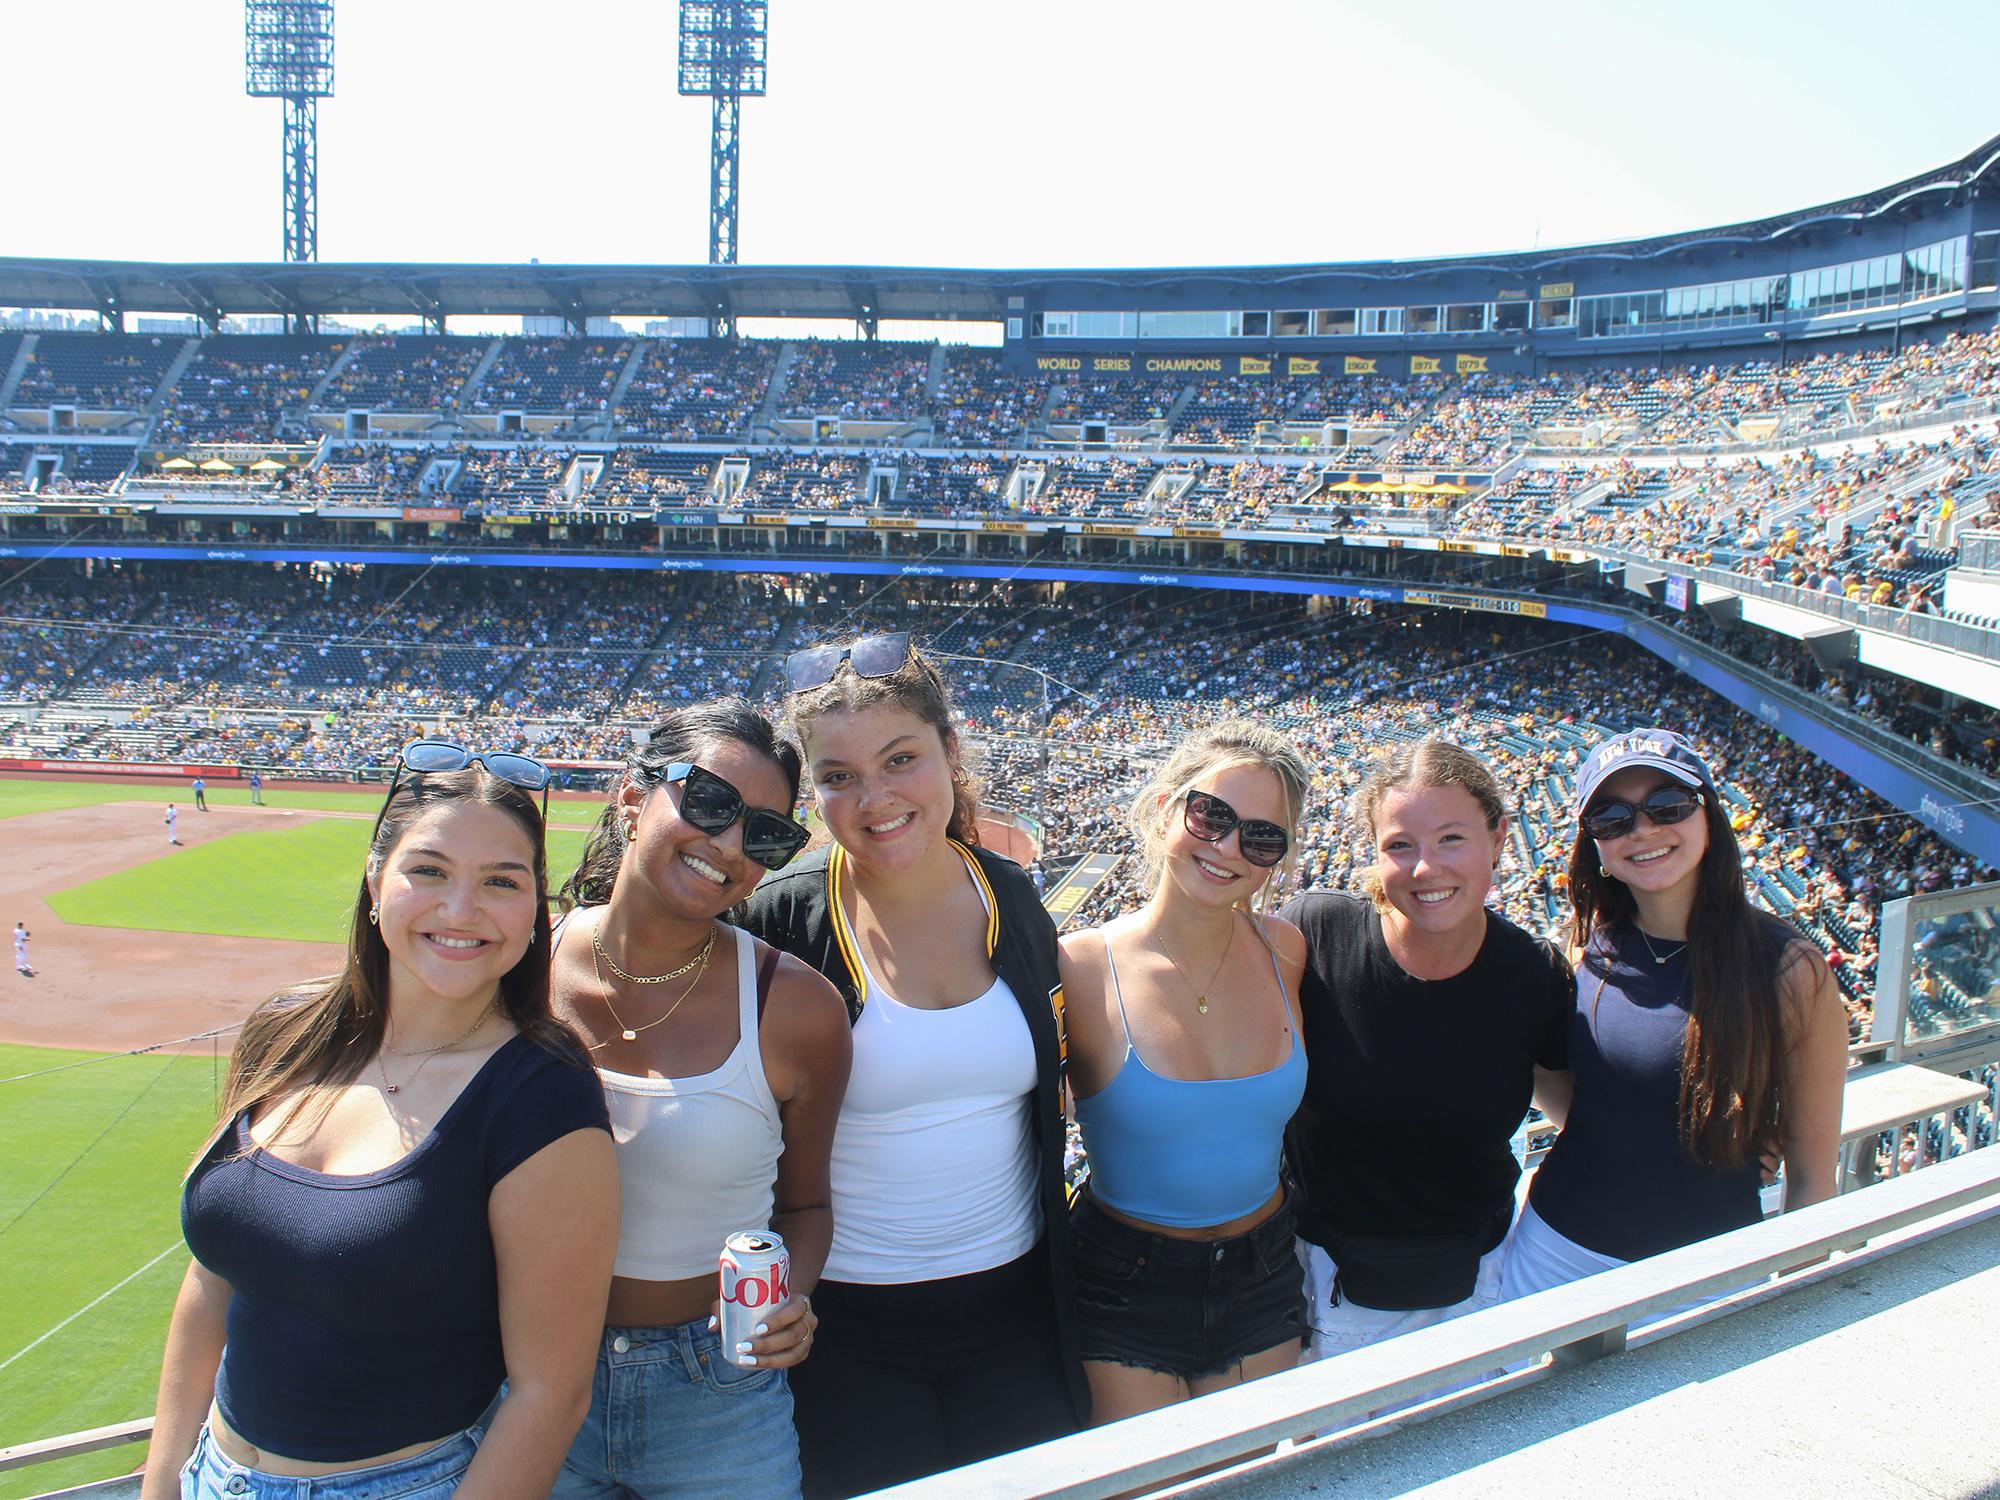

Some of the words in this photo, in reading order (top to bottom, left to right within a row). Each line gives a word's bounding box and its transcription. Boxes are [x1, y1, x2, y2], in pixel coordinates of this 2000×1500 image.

[1037, 358, 1081, 370] WORLD
[1094, 358, 1130, 371] SERIES
[1146, 359, 1222, 371] CHAMPIONS
[1291, 363, 1312, 371] 1925
[1348, 362, 1369, 370] 1960
[1414, 361, 1433, 370] 1971
[1458, 360, 1480, 369] 1979
[619, 511, 629, 524] 0
[683, 515, 703, 524] AHN
[1628, 737, 1666, 758] YORK
